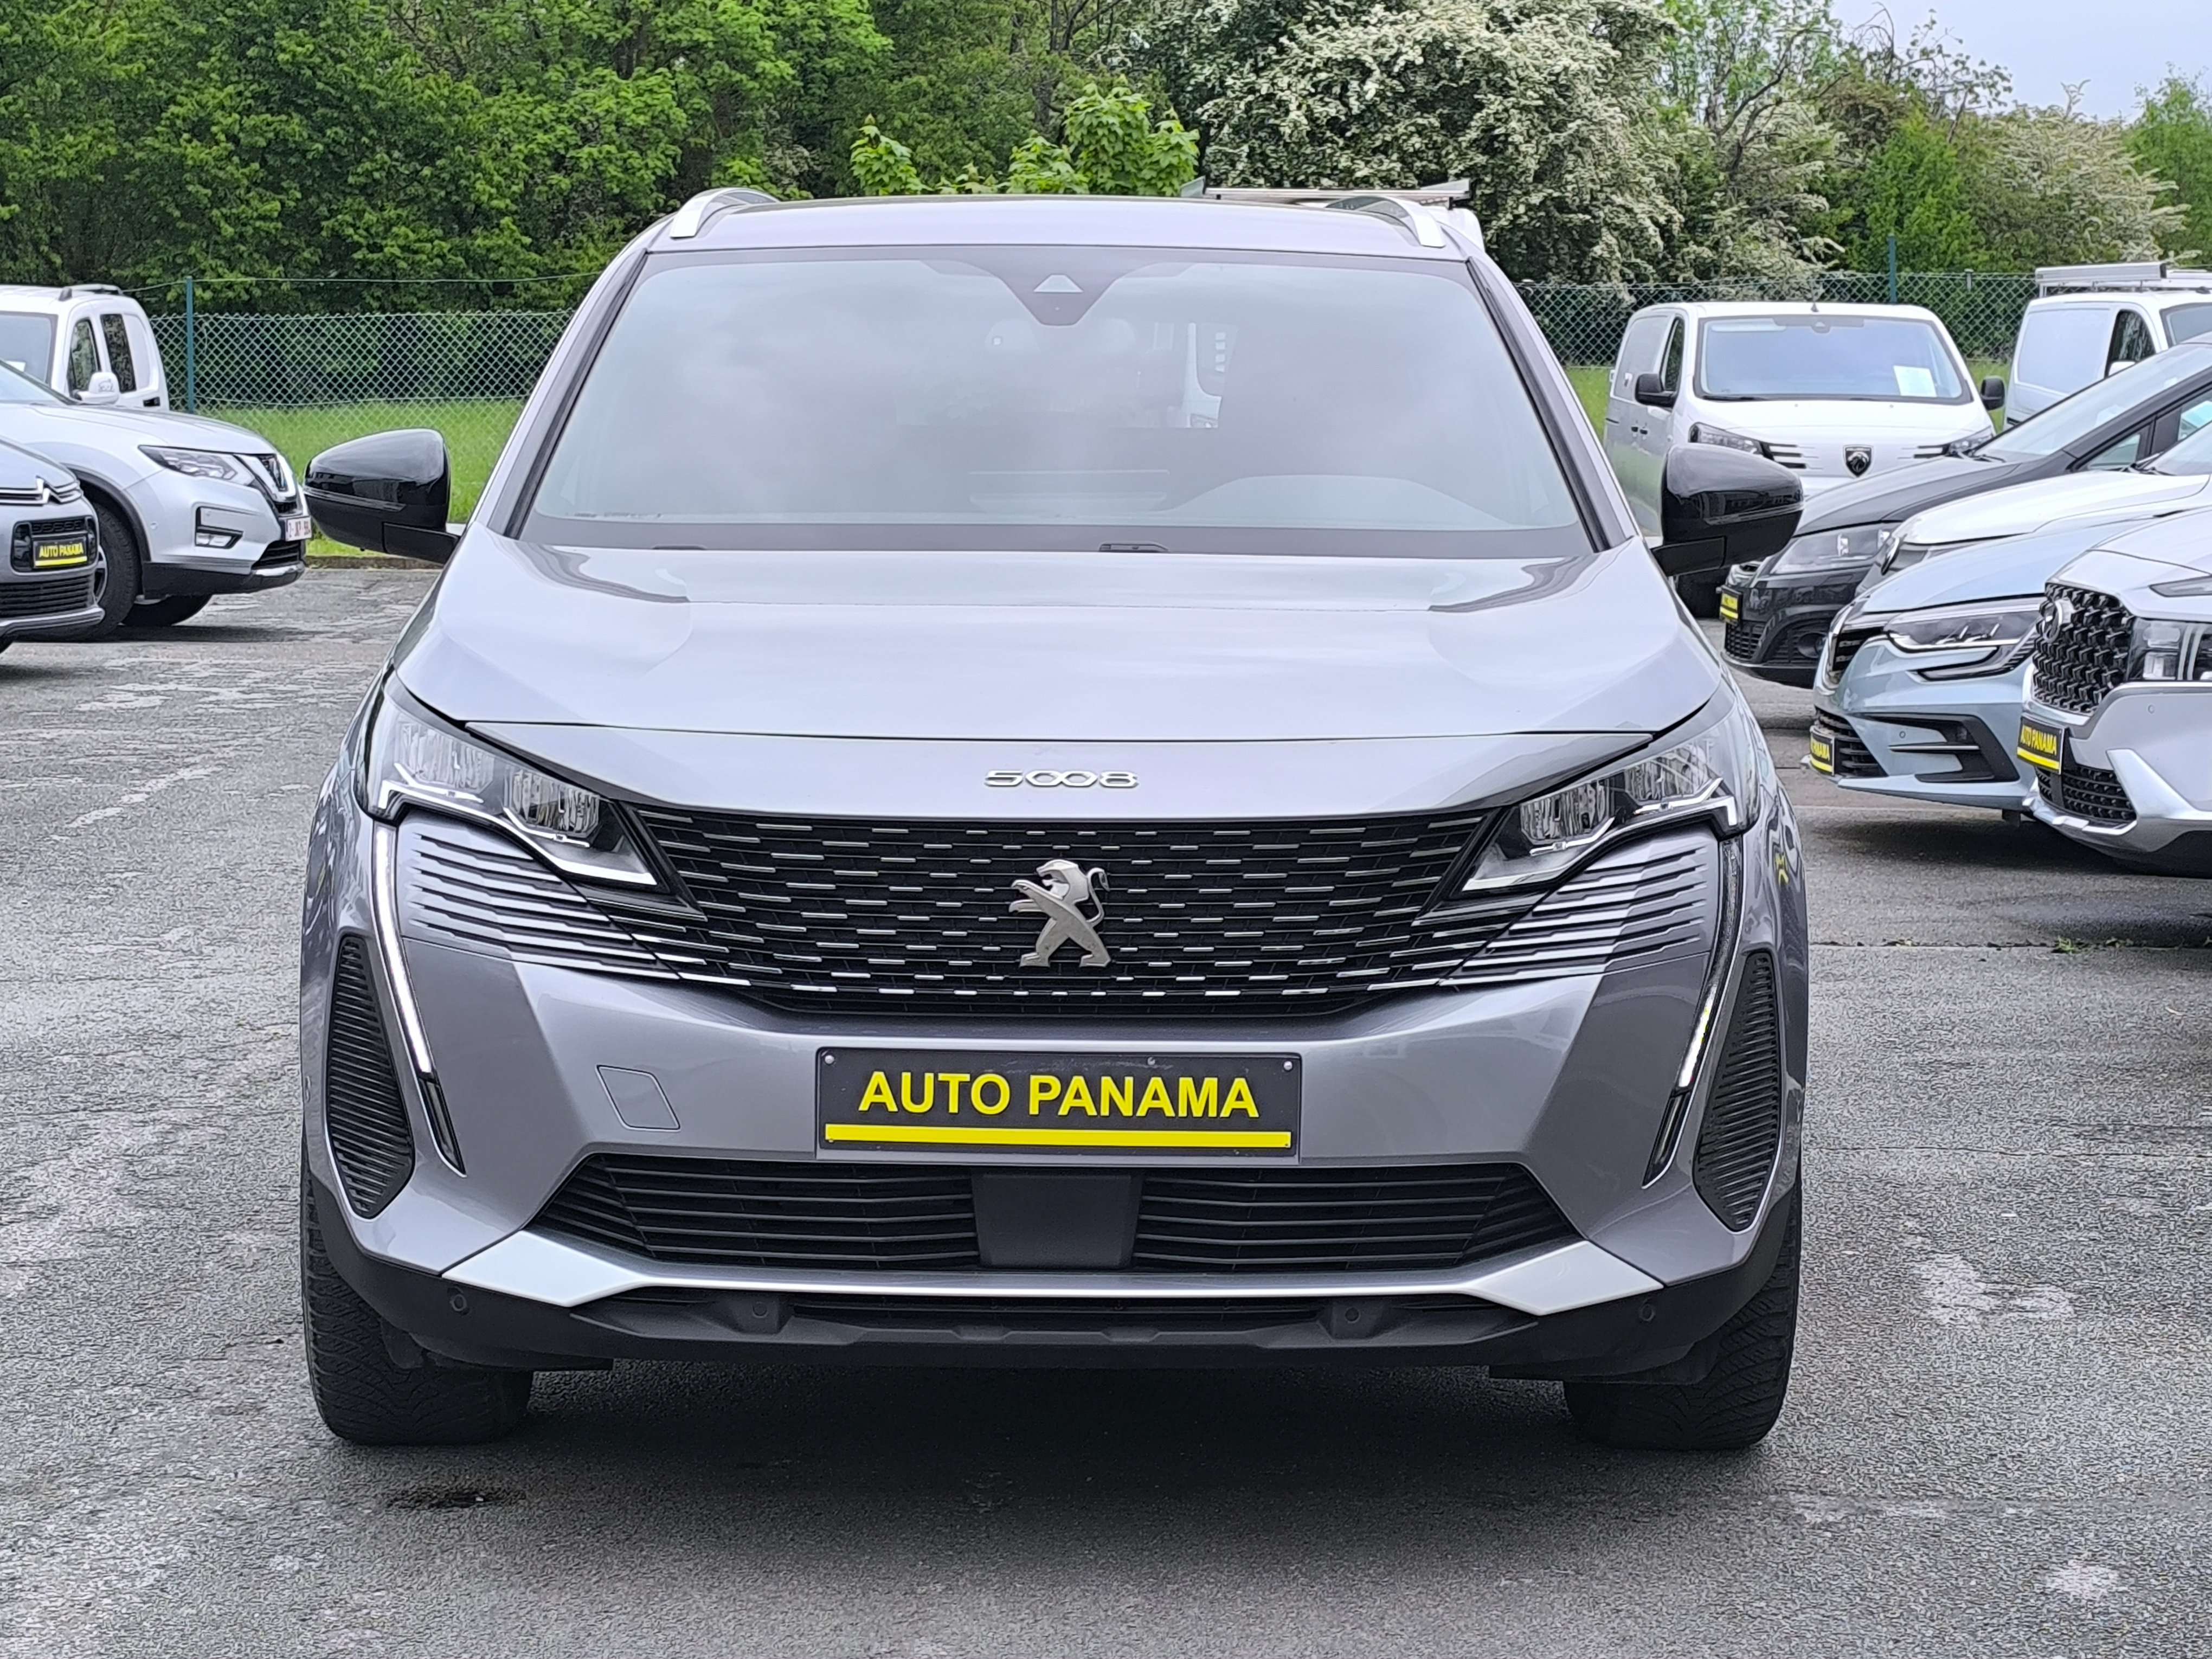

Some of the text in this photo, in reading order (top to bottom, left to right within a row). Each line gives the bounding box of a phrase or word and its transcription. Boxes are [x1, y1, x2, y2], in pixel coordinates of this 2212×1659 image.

[39, 545, 58, 557] AUTO
[2031, 728, 2057, 755] PANAMA
[985, 770, 1139, 788] 5008
[859, 1071, 1259, 1118] AUTO PANAMA
